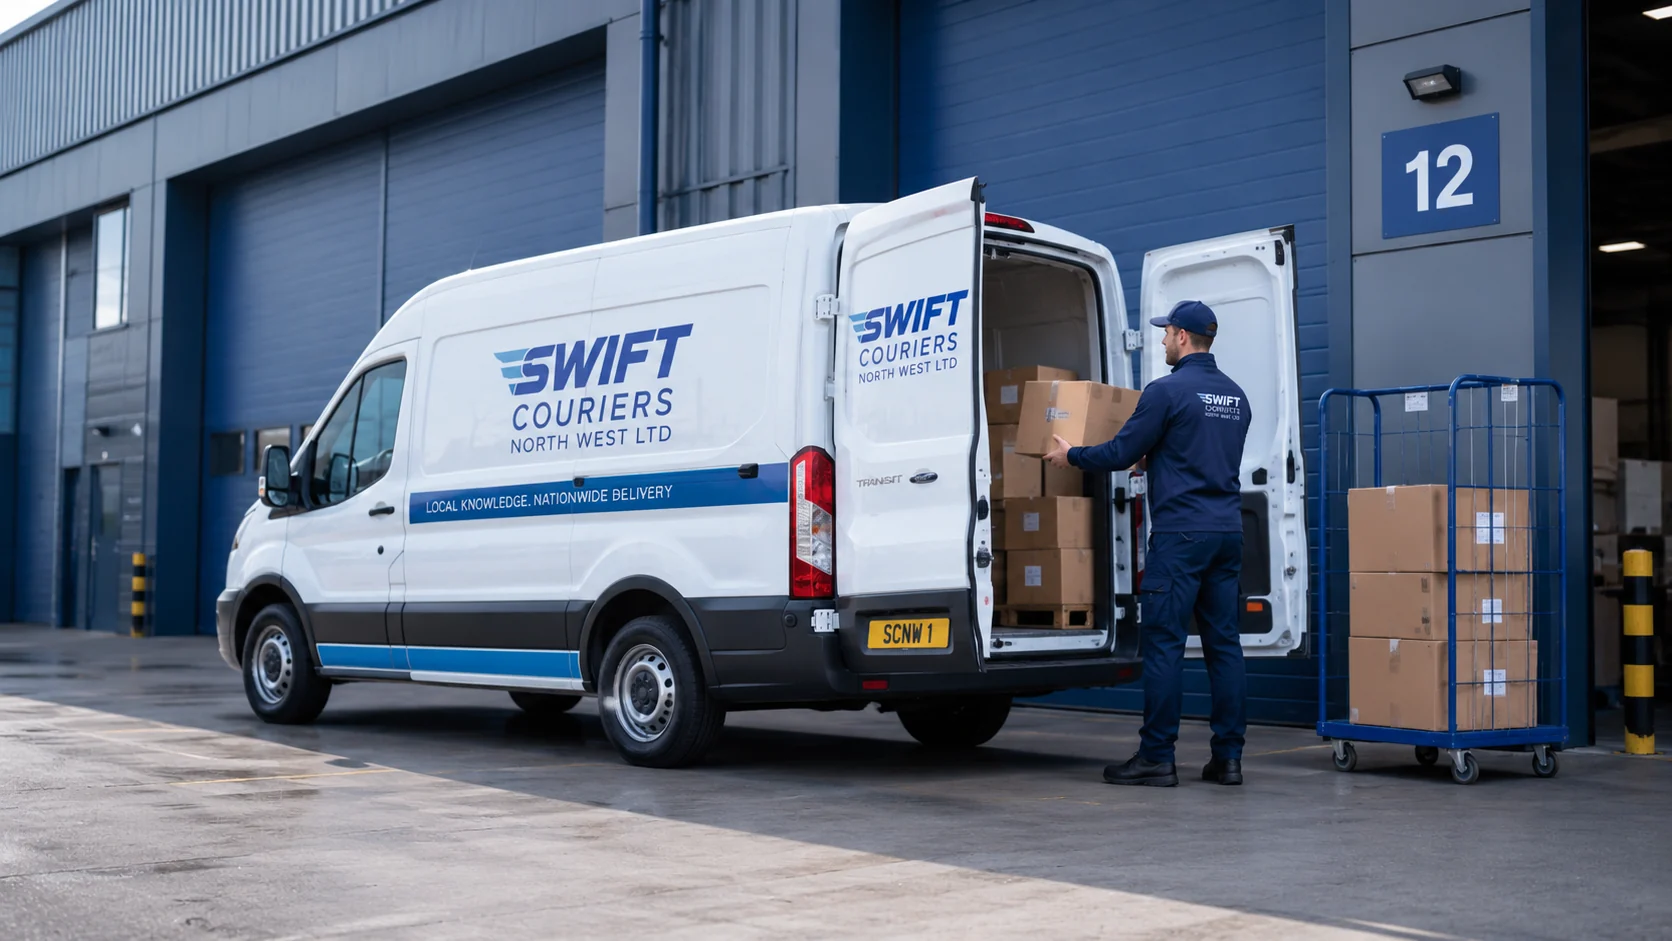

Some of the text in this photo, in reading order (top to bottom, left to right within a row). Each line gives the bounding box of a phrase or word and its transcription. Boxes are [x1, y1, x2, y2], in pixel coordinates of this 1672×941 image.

[1405, 143, 1474, 212] 12
[860, 289, 969, 343] SWIFT
[513, 323, 694, 396] SWIFT
[859, 332, 958, 367] COURIERS
[858, 357, 958, 384] NORTH WEST LTD
[512, 387, 673, 431] COURIERS
[1204, 393, 1241, 407] SWIFT
[510, 425, 672, 454] NORTH WEST LTD
[426, 500, 458, 513] LOCAL
[461, 494, 531, 511] KNOWLEDGE.
[533, 489, 608, 506] NATIONWIDE
[883, 622, 933, 644] SCNW 1
